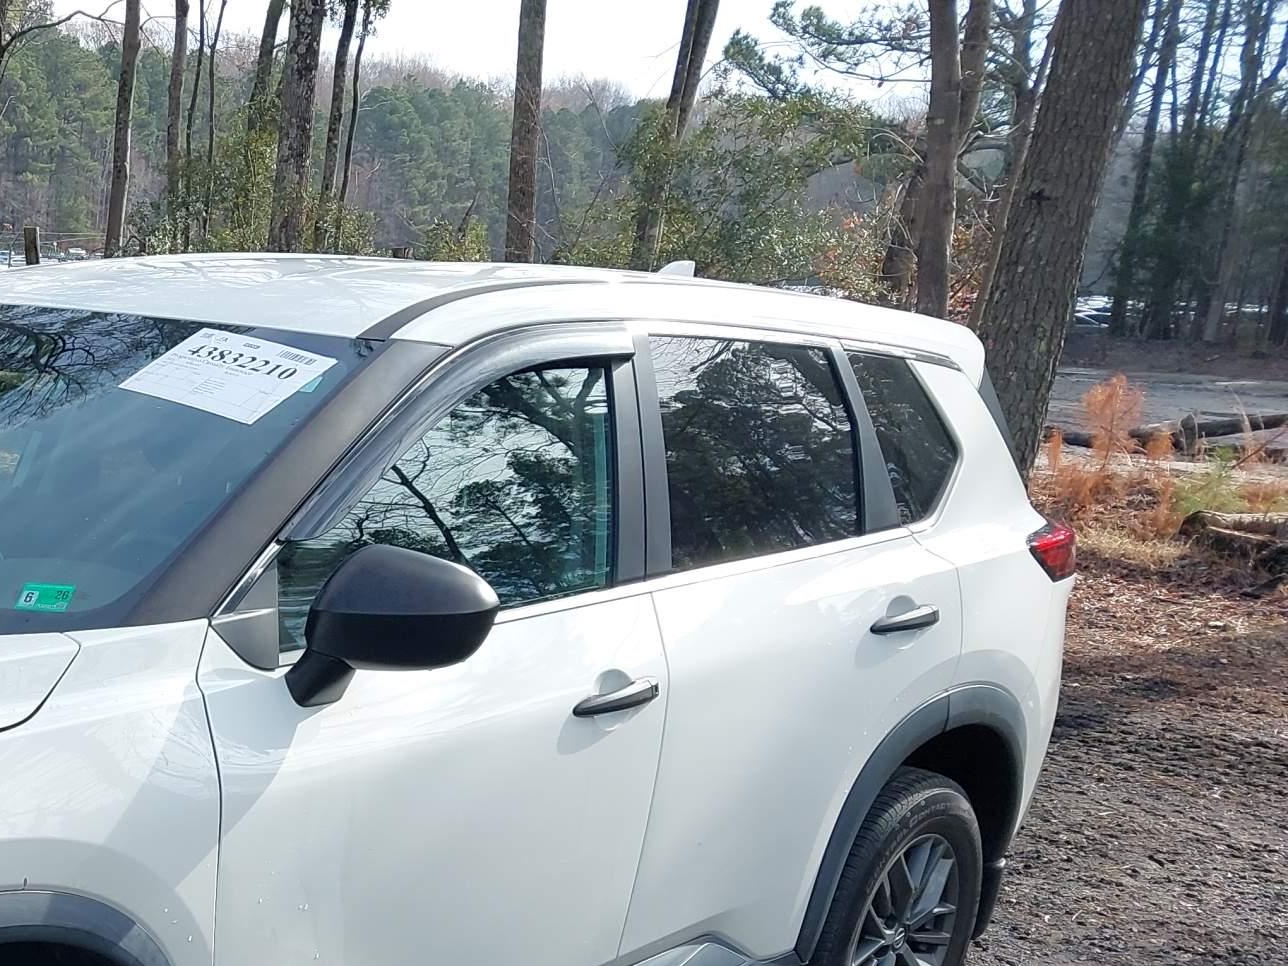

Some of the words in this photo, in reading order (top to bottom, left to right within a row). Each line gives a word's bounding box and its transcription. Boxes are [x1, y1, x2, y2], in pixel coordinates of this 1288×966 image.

[187, 344, 298, 380] 43832210
[23, 591, 35, 603] 6
[54, 590, 70, 601] 26
